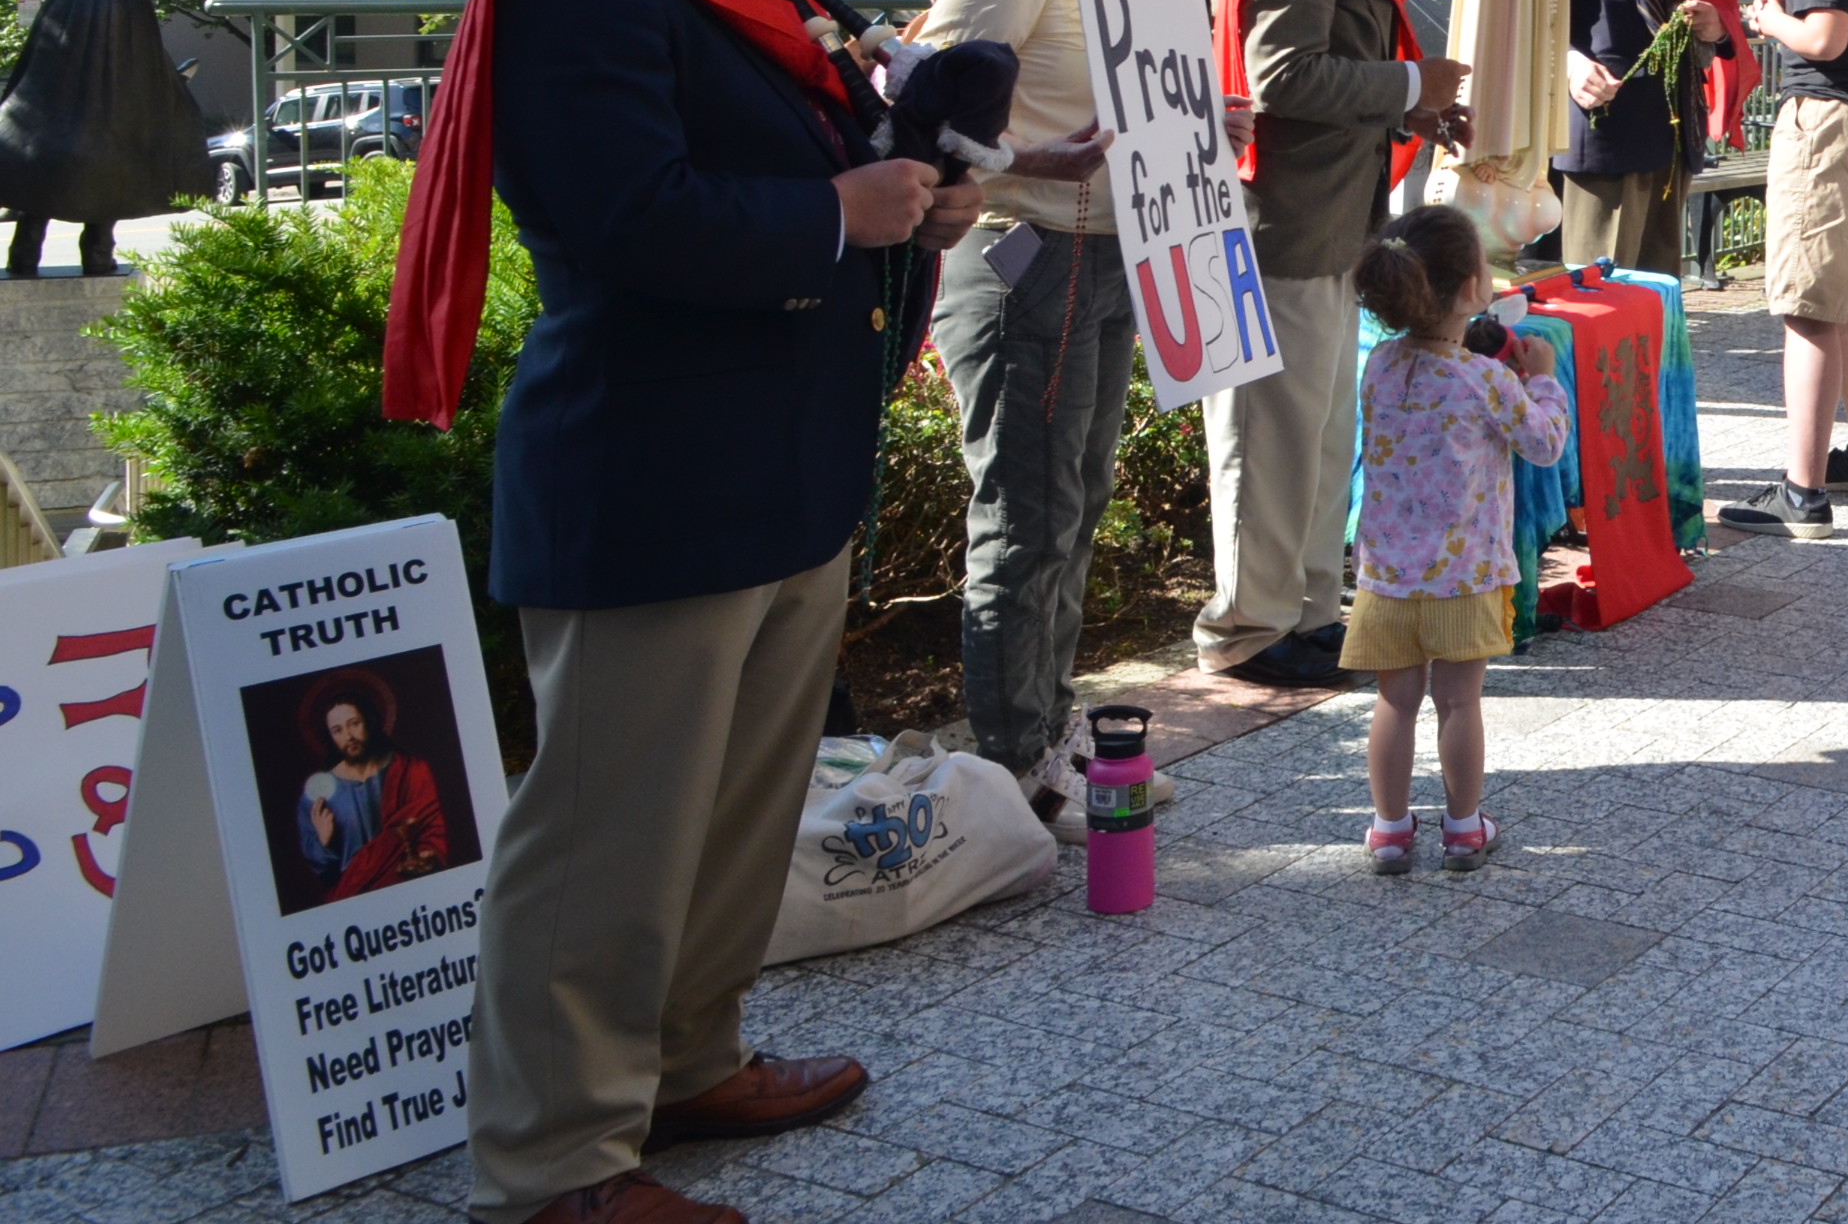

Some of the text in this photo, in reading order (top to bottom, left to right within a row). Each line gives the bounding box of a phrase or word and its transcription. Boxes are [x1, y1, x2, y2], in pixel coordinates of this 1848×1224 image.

[1131, 130, 1232, 243] for the
[1136, 228, 1275, 383] USA
[223, 558, 428, 620] CATHOLIC
[260, 606, 400, 656] TRUTH
[287, 933, 339, 979] Got
[296, 954, 479, 1036] Free Literatur
[306, 1036, 381, 1094] Need
[317, 1100, 378, 1155] Find
[381, 1088, 445, 1130] True
